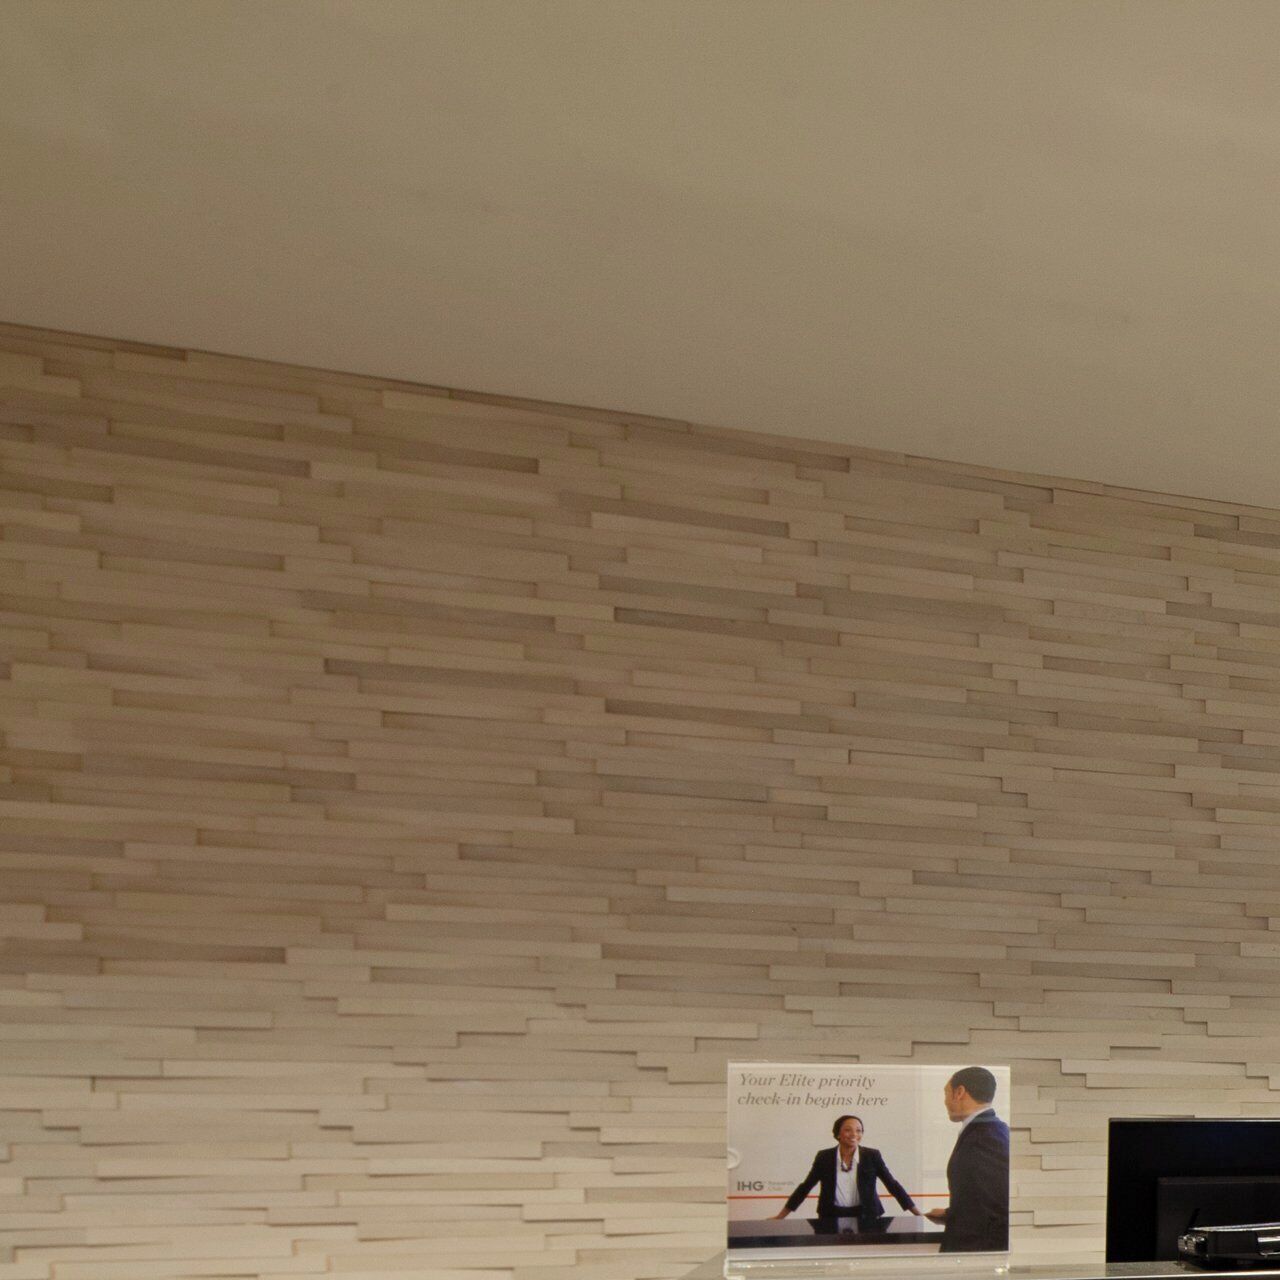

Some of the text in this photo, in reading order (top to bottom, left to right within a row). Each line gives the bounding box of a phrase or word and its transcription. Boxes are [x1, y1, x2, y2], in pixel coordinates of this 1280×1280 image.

[739, 1073, 876, 1090] Your Elite priority
[737, 1092, 889, 1108] check-in begins here
[737, 1181, 764, 1191] IHG
